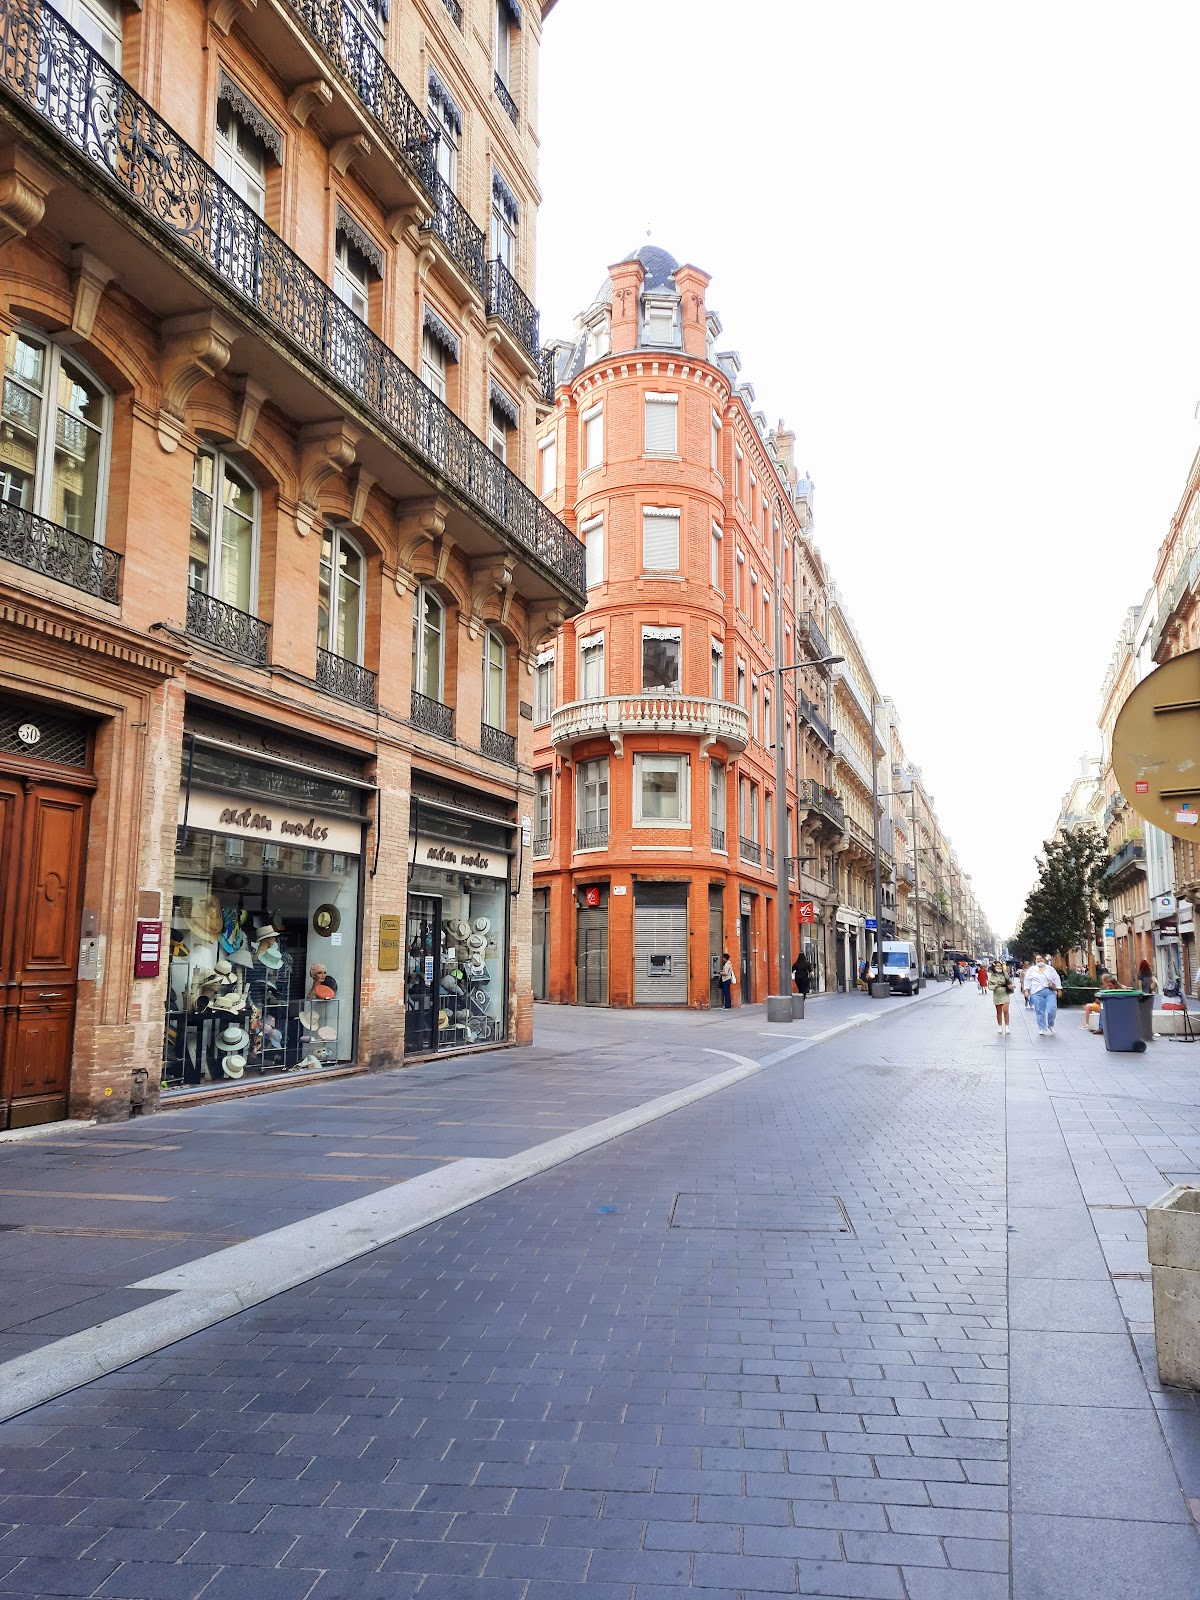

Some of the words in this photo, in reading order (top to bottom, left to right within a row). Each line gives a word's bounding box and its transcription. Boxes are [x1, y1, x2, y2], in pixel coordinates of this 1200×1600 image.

[22, 726, 37, 741] 50
[220, 807, 272, 832] autan
[281, 818, 329, 841] modes
[427, 846, 457, 865] autan
[461, 853, 489, 870] modes
